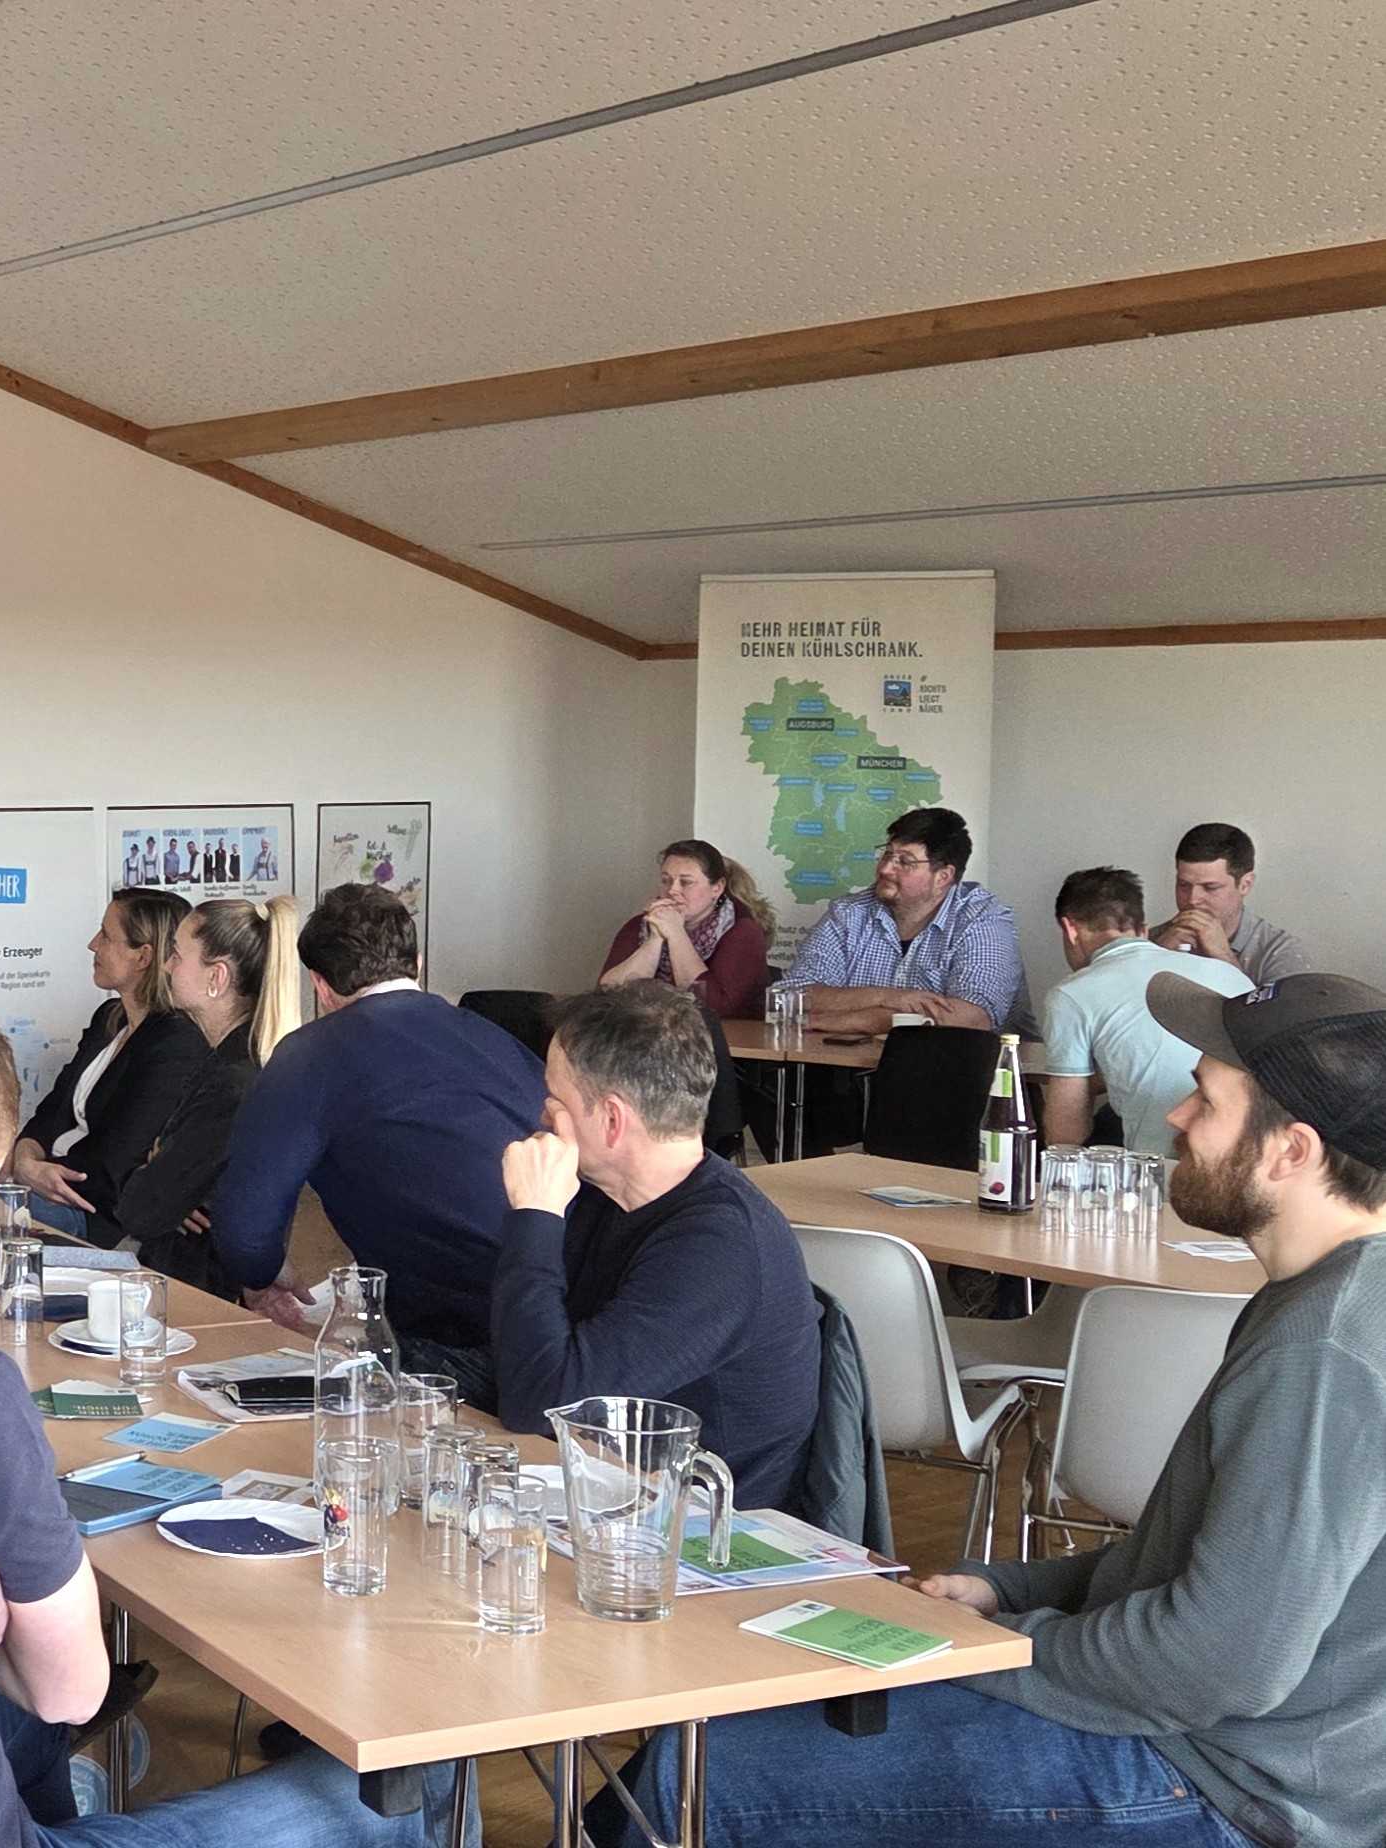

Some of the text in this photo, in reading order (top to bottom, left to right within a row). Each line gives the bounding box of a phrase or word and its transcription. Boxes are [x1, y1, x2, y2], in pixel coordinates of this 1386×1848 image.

[741, 617, 882, 638] MEHR HEIMAT FÜR
[741, 638, 924, 658] DEINEN KÜHLSCHRANK.
[788, 720, 833, 729] AUGSBURG
[860, 758, 904, 768] MÜNCHEN
[3, 946, 43, 960] Erzeuger
